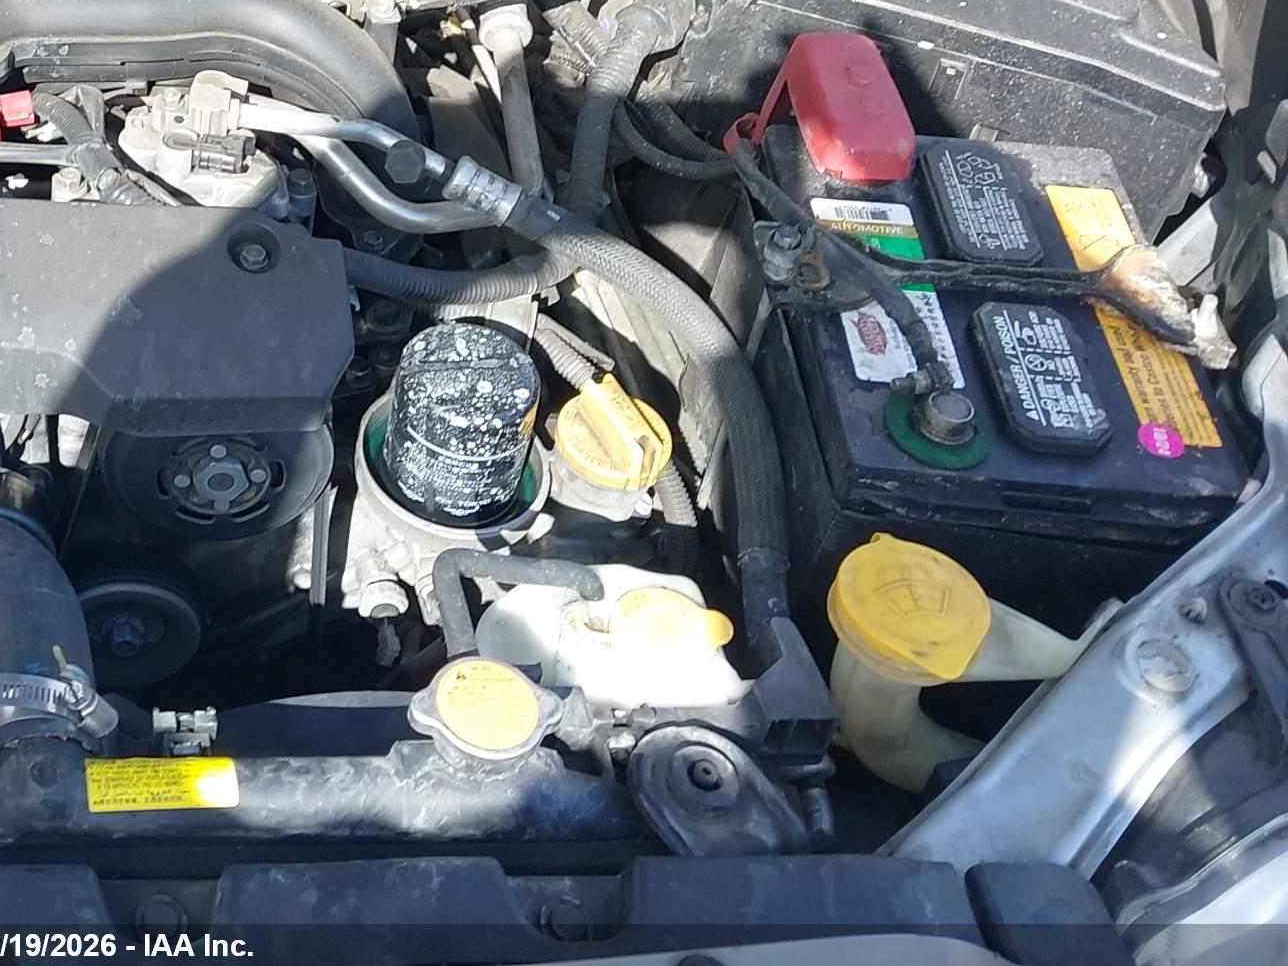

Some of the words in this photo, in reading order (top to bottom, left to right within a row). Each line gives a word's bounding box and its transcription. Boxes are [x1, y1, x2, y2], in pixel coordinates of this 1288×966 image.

[992, 315, 1016, 354] POISON
[1116, 347, 1134, 364] and
[1140, 354, 1160, 385] Costco
[1009, 364, 1037, 409] DANGER
[1128, 366, 1151, 404] warranty
